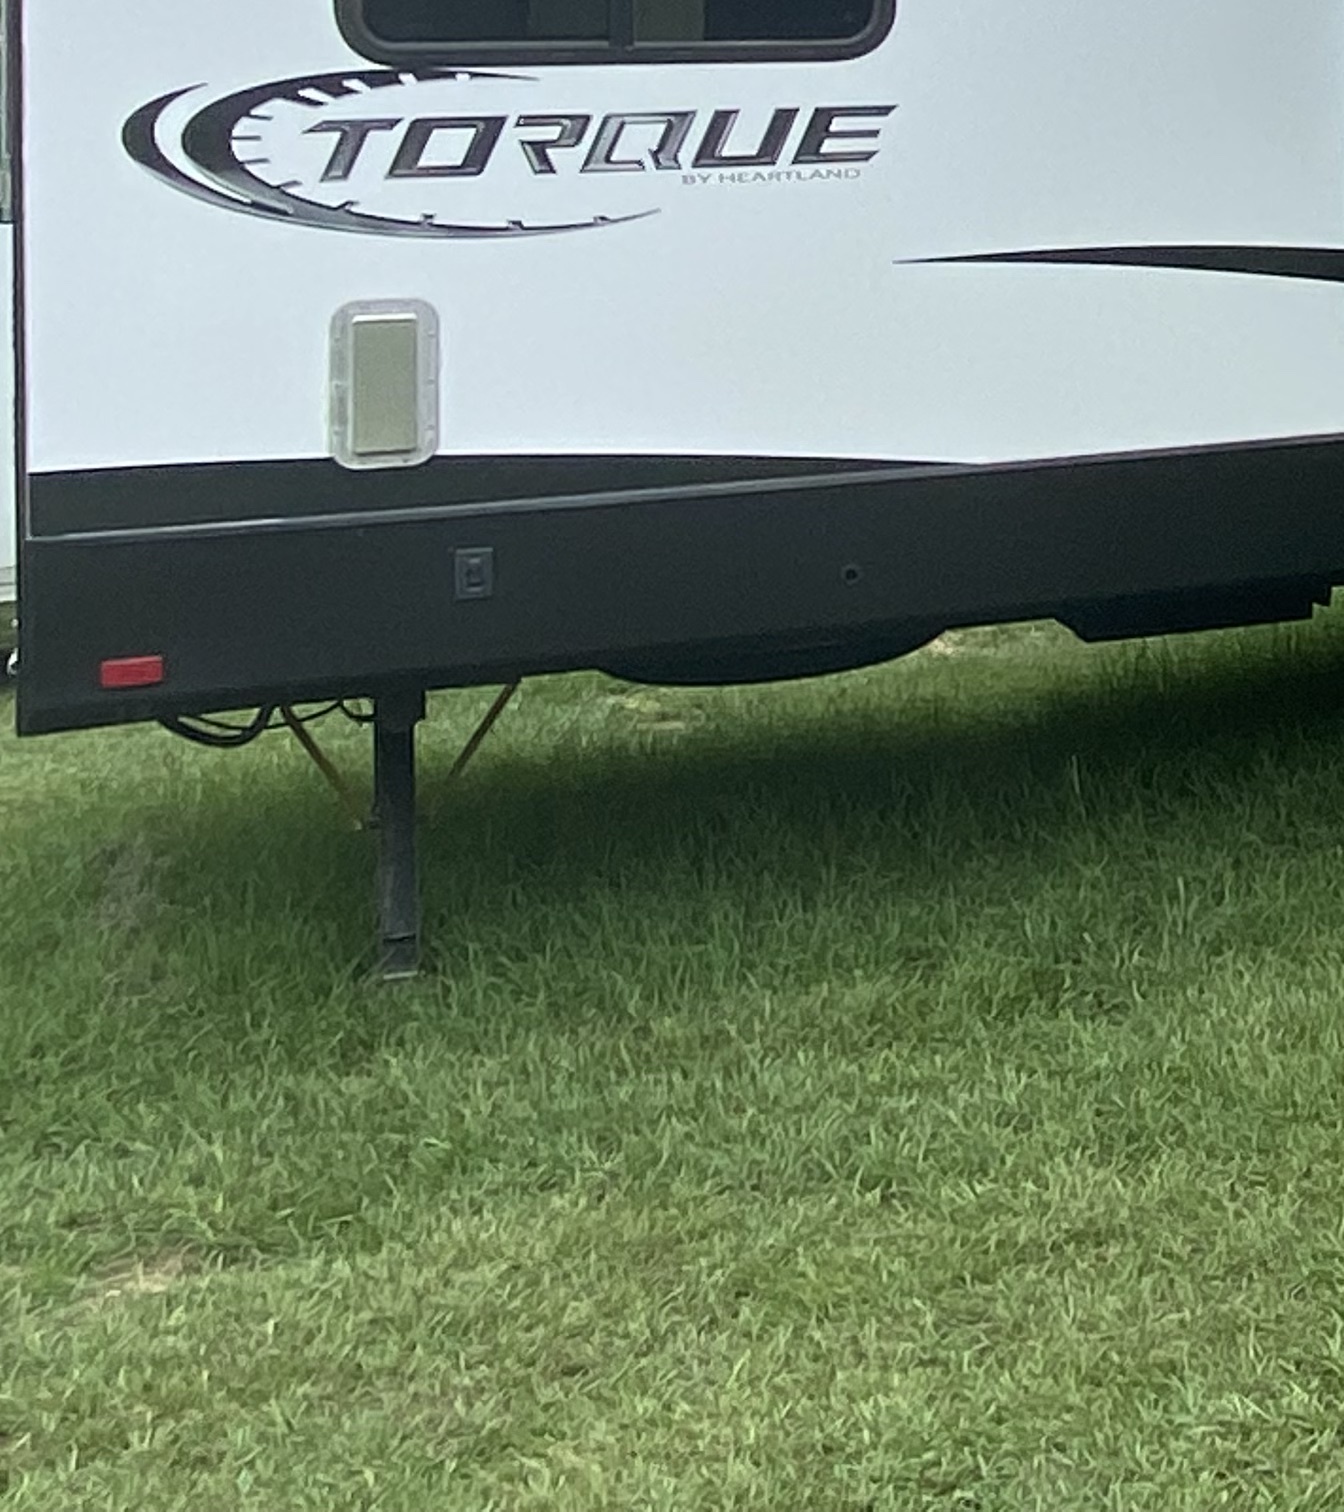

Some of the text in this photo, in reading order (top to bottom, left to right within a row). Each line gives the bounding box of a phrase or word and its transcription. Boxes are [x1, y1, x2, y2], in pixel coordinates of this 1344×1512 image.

[303, 104, 899, 183] TORQUE
[681, 167, 861, 185] BY HEARTLAND
